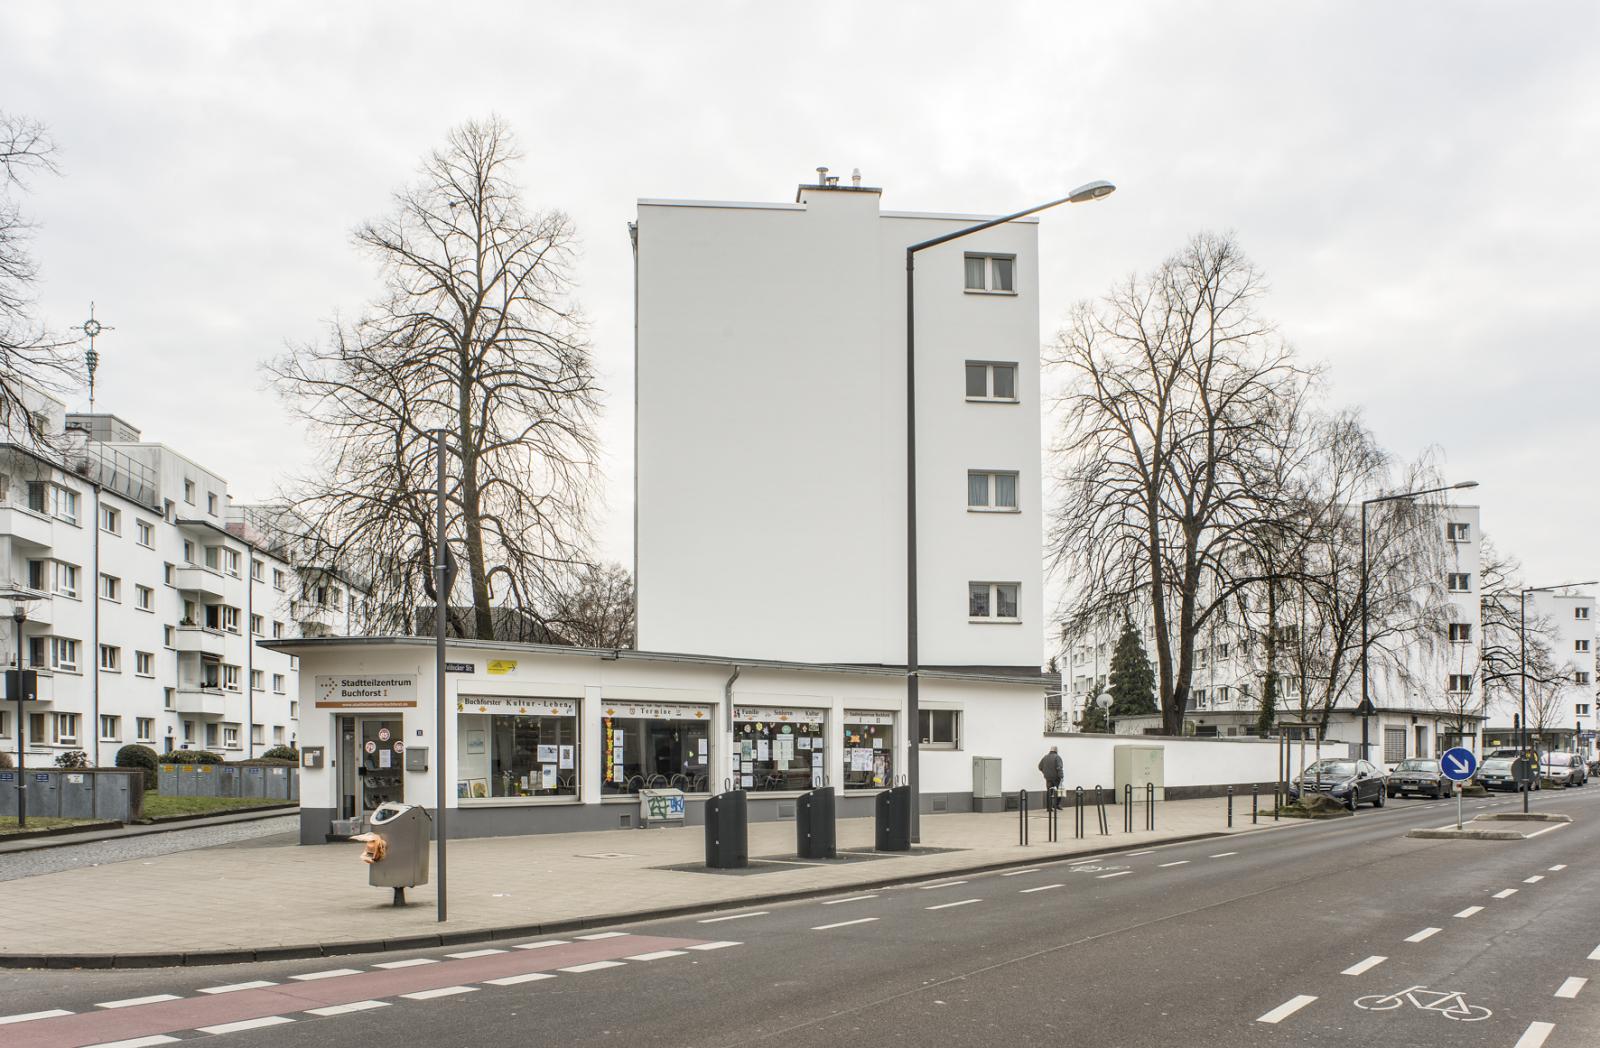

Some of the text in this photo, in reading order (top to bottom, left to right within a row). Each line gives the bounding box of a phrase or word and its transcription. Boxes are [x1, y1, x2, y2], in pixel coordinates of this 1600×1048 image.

[341, 679, 412, 687] Stadtteilzentrum
[341, 689, 382, 697] Buchforst
[464, 697, 501, 706] Buchforster
[506, 699, 536, 707] Kultur
[543, 700, 569, 708] Leben
[640, 707, 672, 715] Termine
